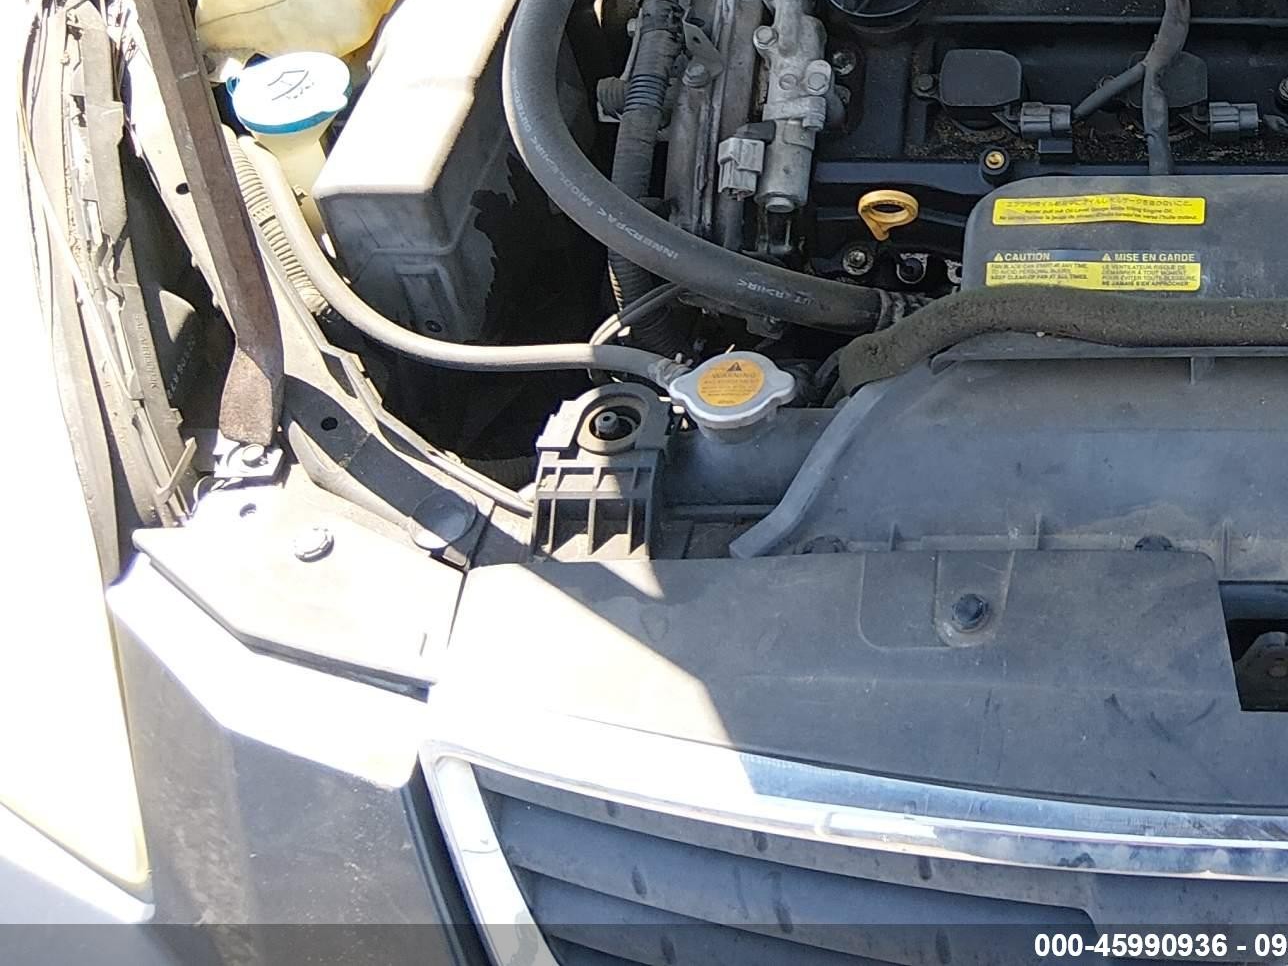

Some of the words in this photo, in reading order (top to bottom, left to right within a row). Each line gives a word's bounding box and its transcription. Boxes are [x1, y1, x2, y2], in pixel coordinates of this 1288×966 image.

[1004, 252, 1050, 262] CAUTION
[1114, 253, 1140, 262] MISE
[1142, 253, 1157, 262] EN
[1159, 253, 1195, 262] GARDE
